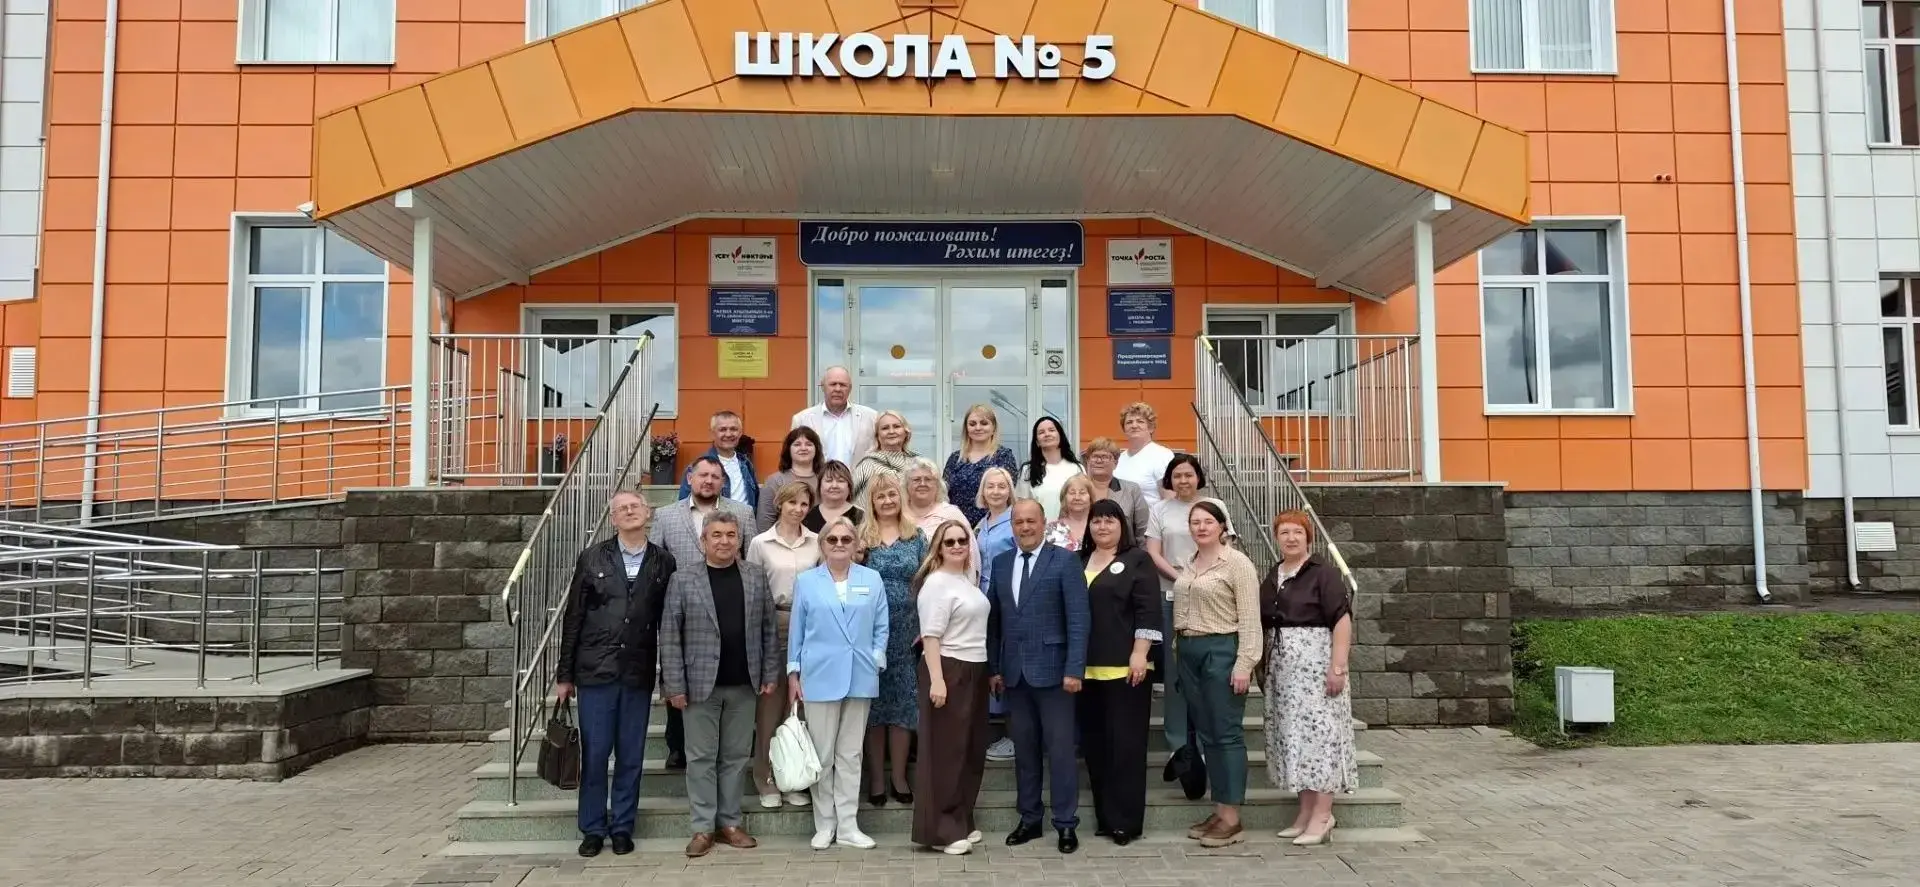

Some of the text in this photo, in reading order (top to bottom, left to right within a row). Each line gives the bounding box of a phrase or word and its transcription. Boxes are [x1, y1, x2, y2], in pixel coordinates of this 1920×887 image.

[735, 31, 1117, 81] ШКОЛА № 5
[811, 226, 998, 245] Добро пожаловать!
[943, 244, 1000, 260] Рәхим
